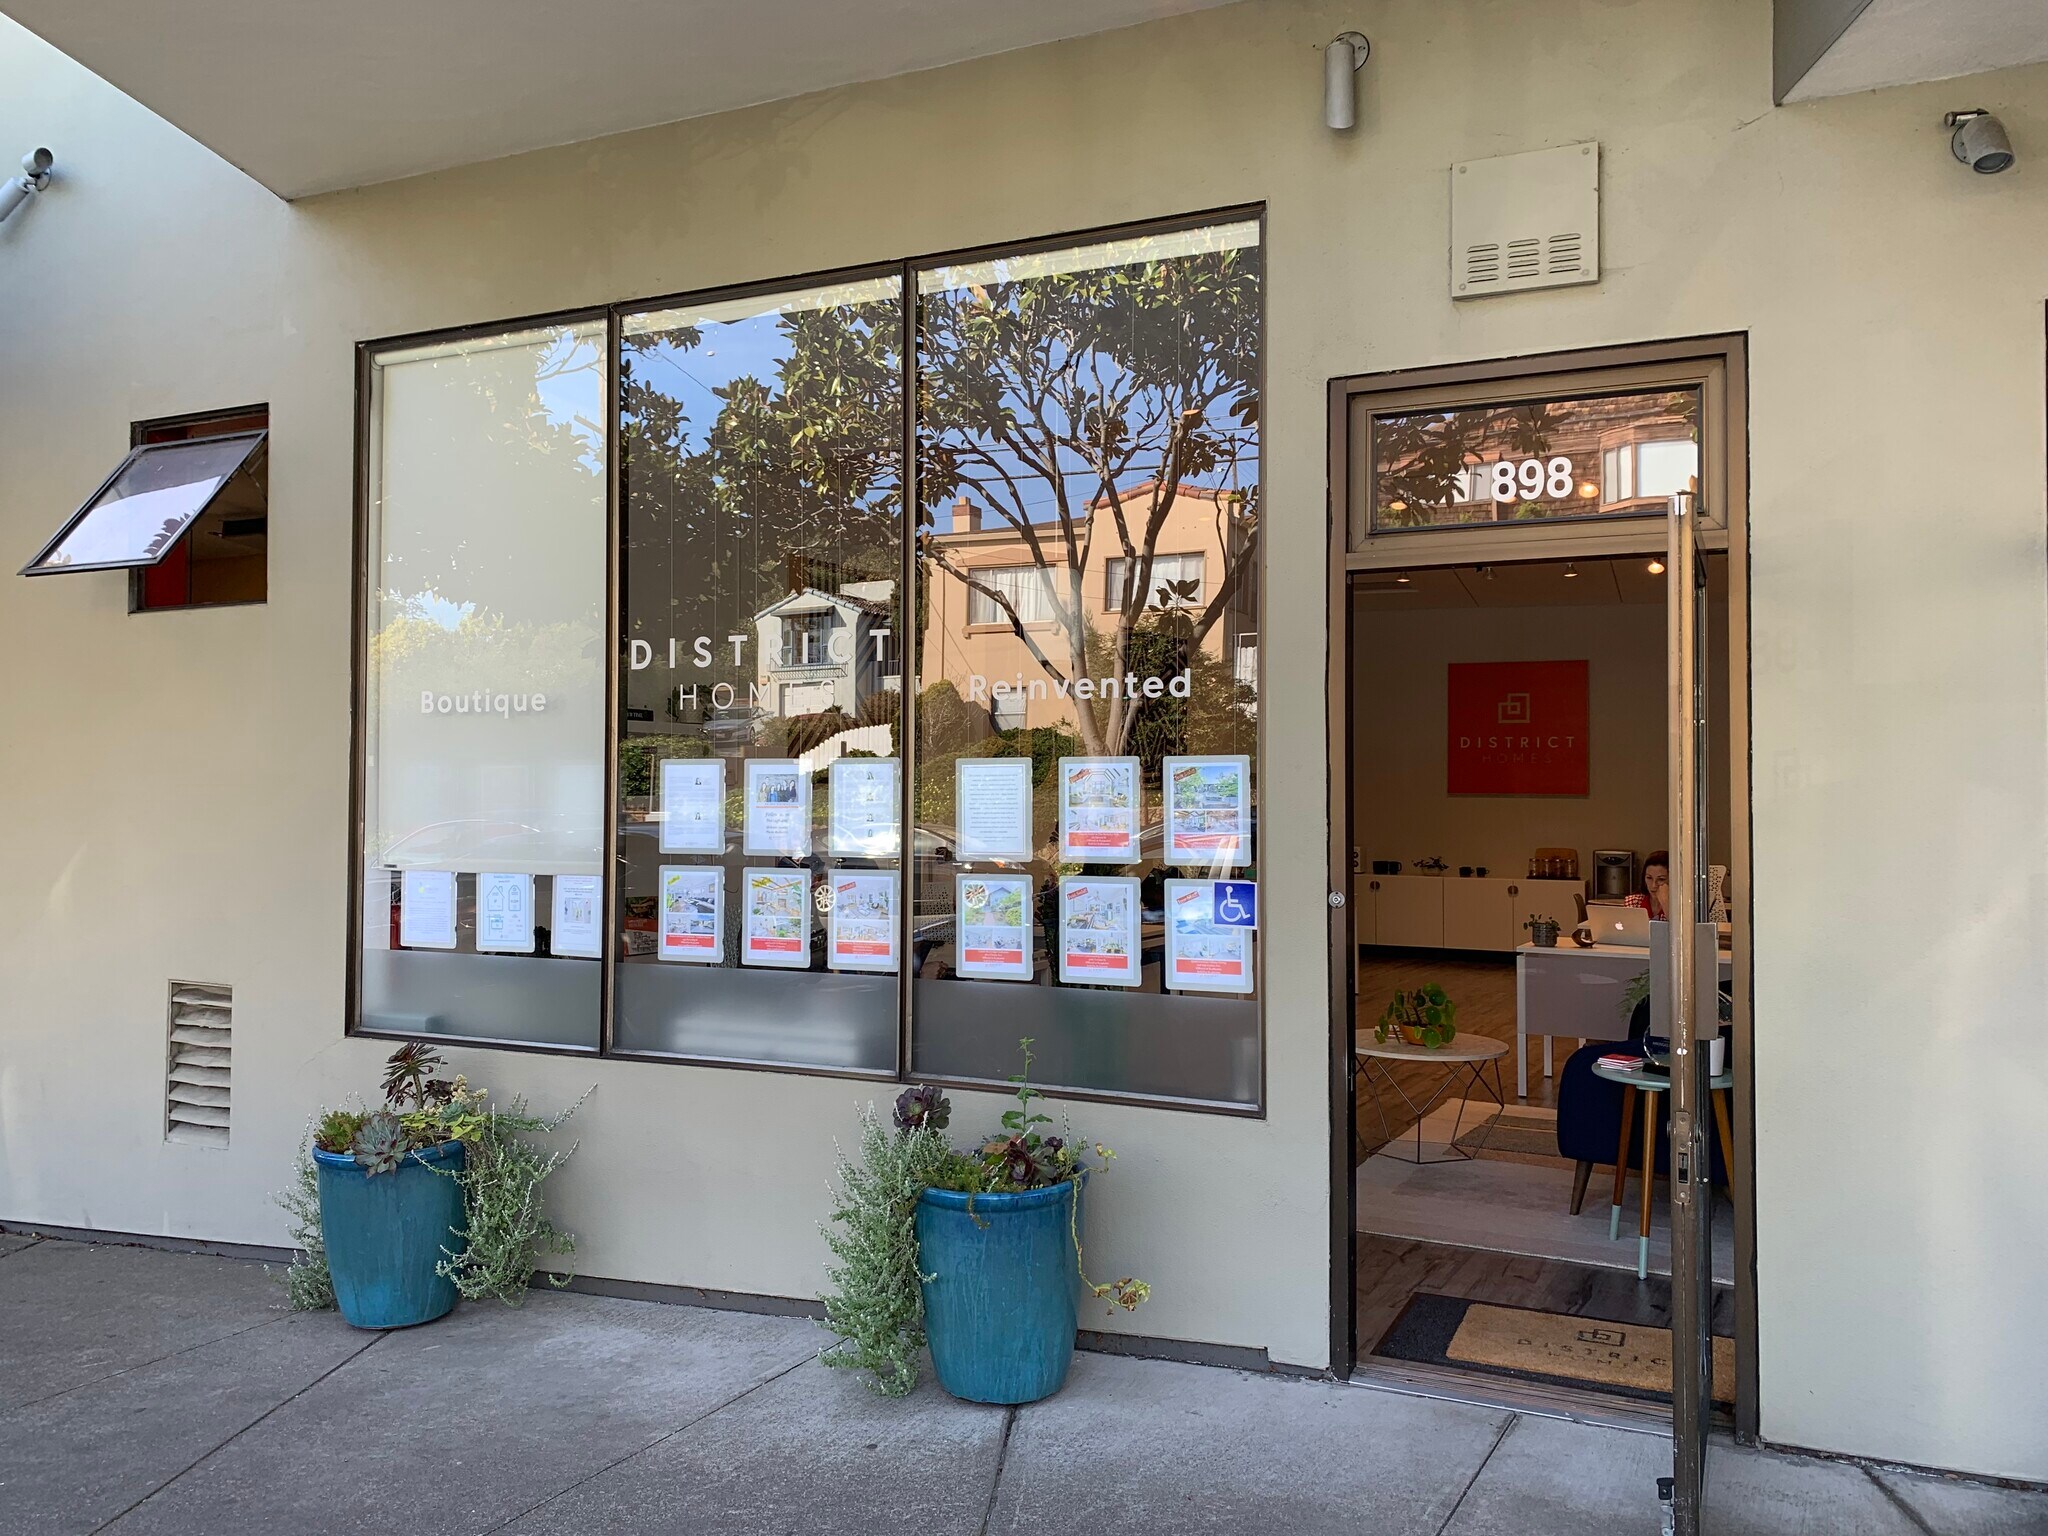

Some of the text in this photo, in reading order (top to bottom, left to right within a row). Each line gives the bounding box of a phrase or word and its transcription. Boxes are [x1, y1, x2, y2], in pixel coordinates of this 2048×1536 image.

[1491, 456, 1574, 502] 898
[630, 628, 891, 670] DISTRICT
[968, 667, 1192, 701] Reinvented
[420, 687, 547, 719] Boutique
[1460, 736, 1575, 749] DISTRICT
[1517, 1338, 1667, 1367] DISTRIC
